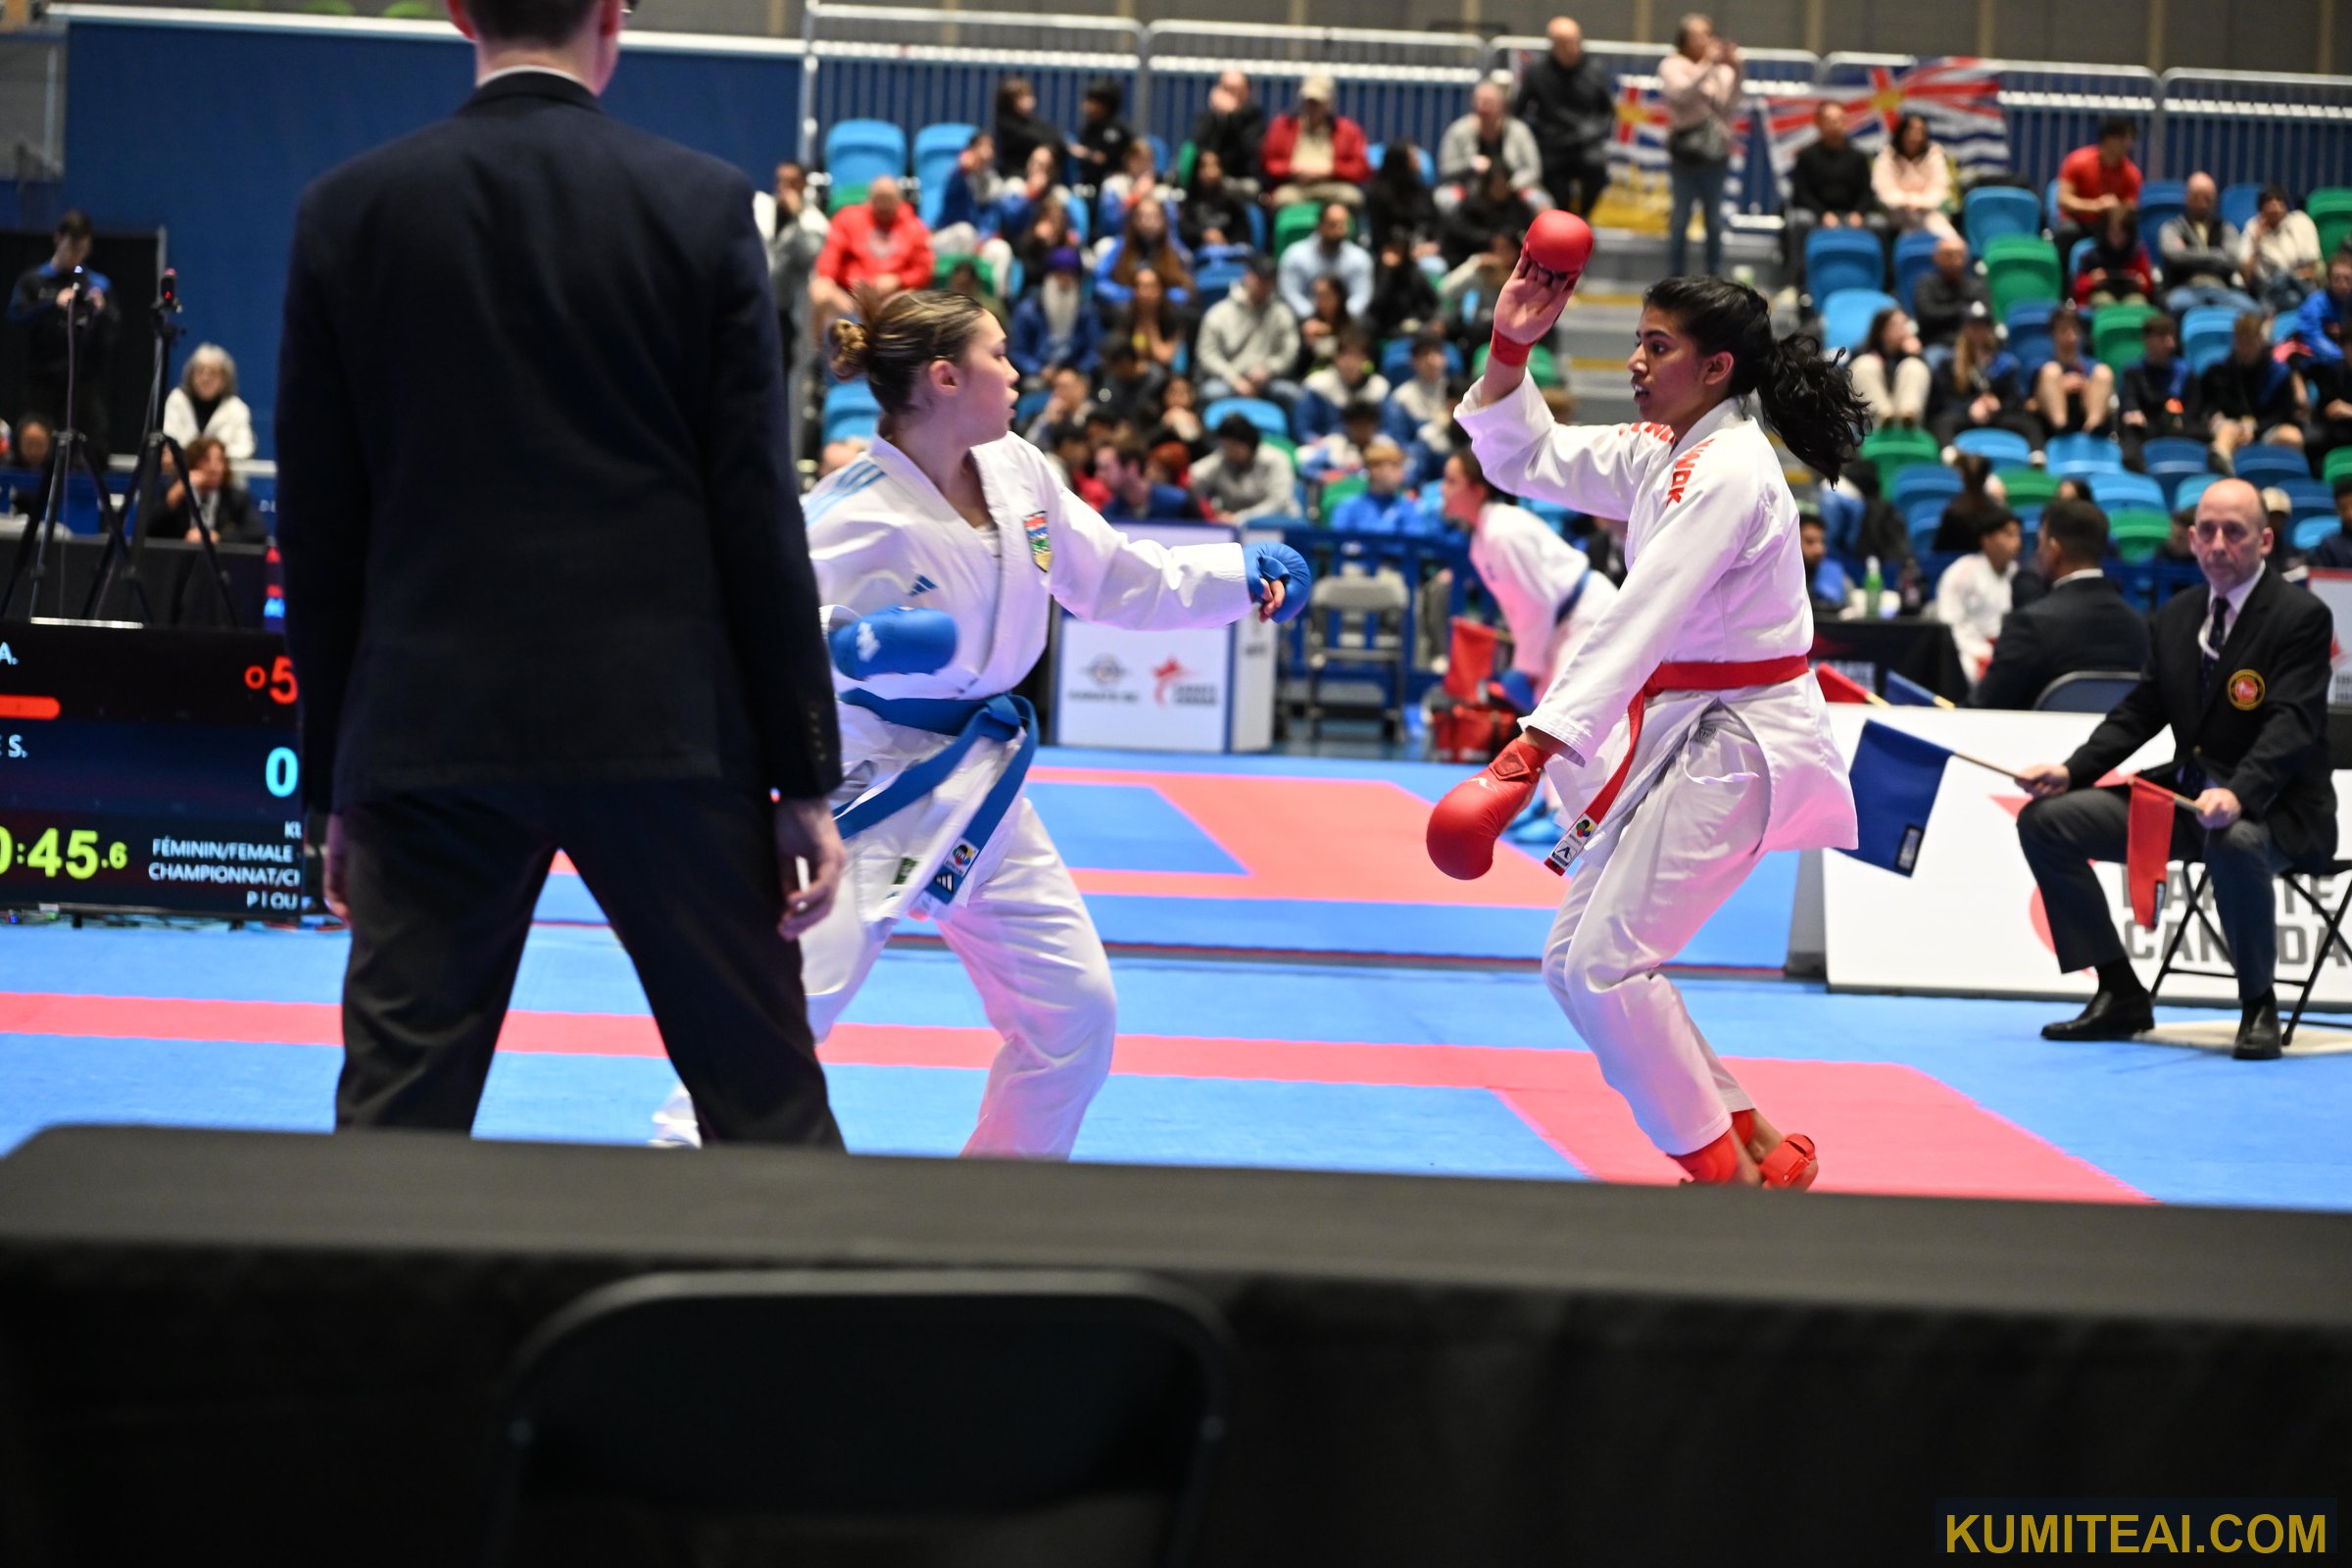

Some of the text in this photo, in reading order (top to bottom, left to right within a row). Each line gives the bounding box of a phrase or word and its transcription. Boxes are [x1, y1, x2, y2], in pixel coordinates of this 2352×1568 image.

[8, 733, 28, 759] S.
[266, 747, 299, 798] 0
[152, 835, 294, 863] FÉMININ/FEMALE
[2124, 919, 2348, 967] CANDA
